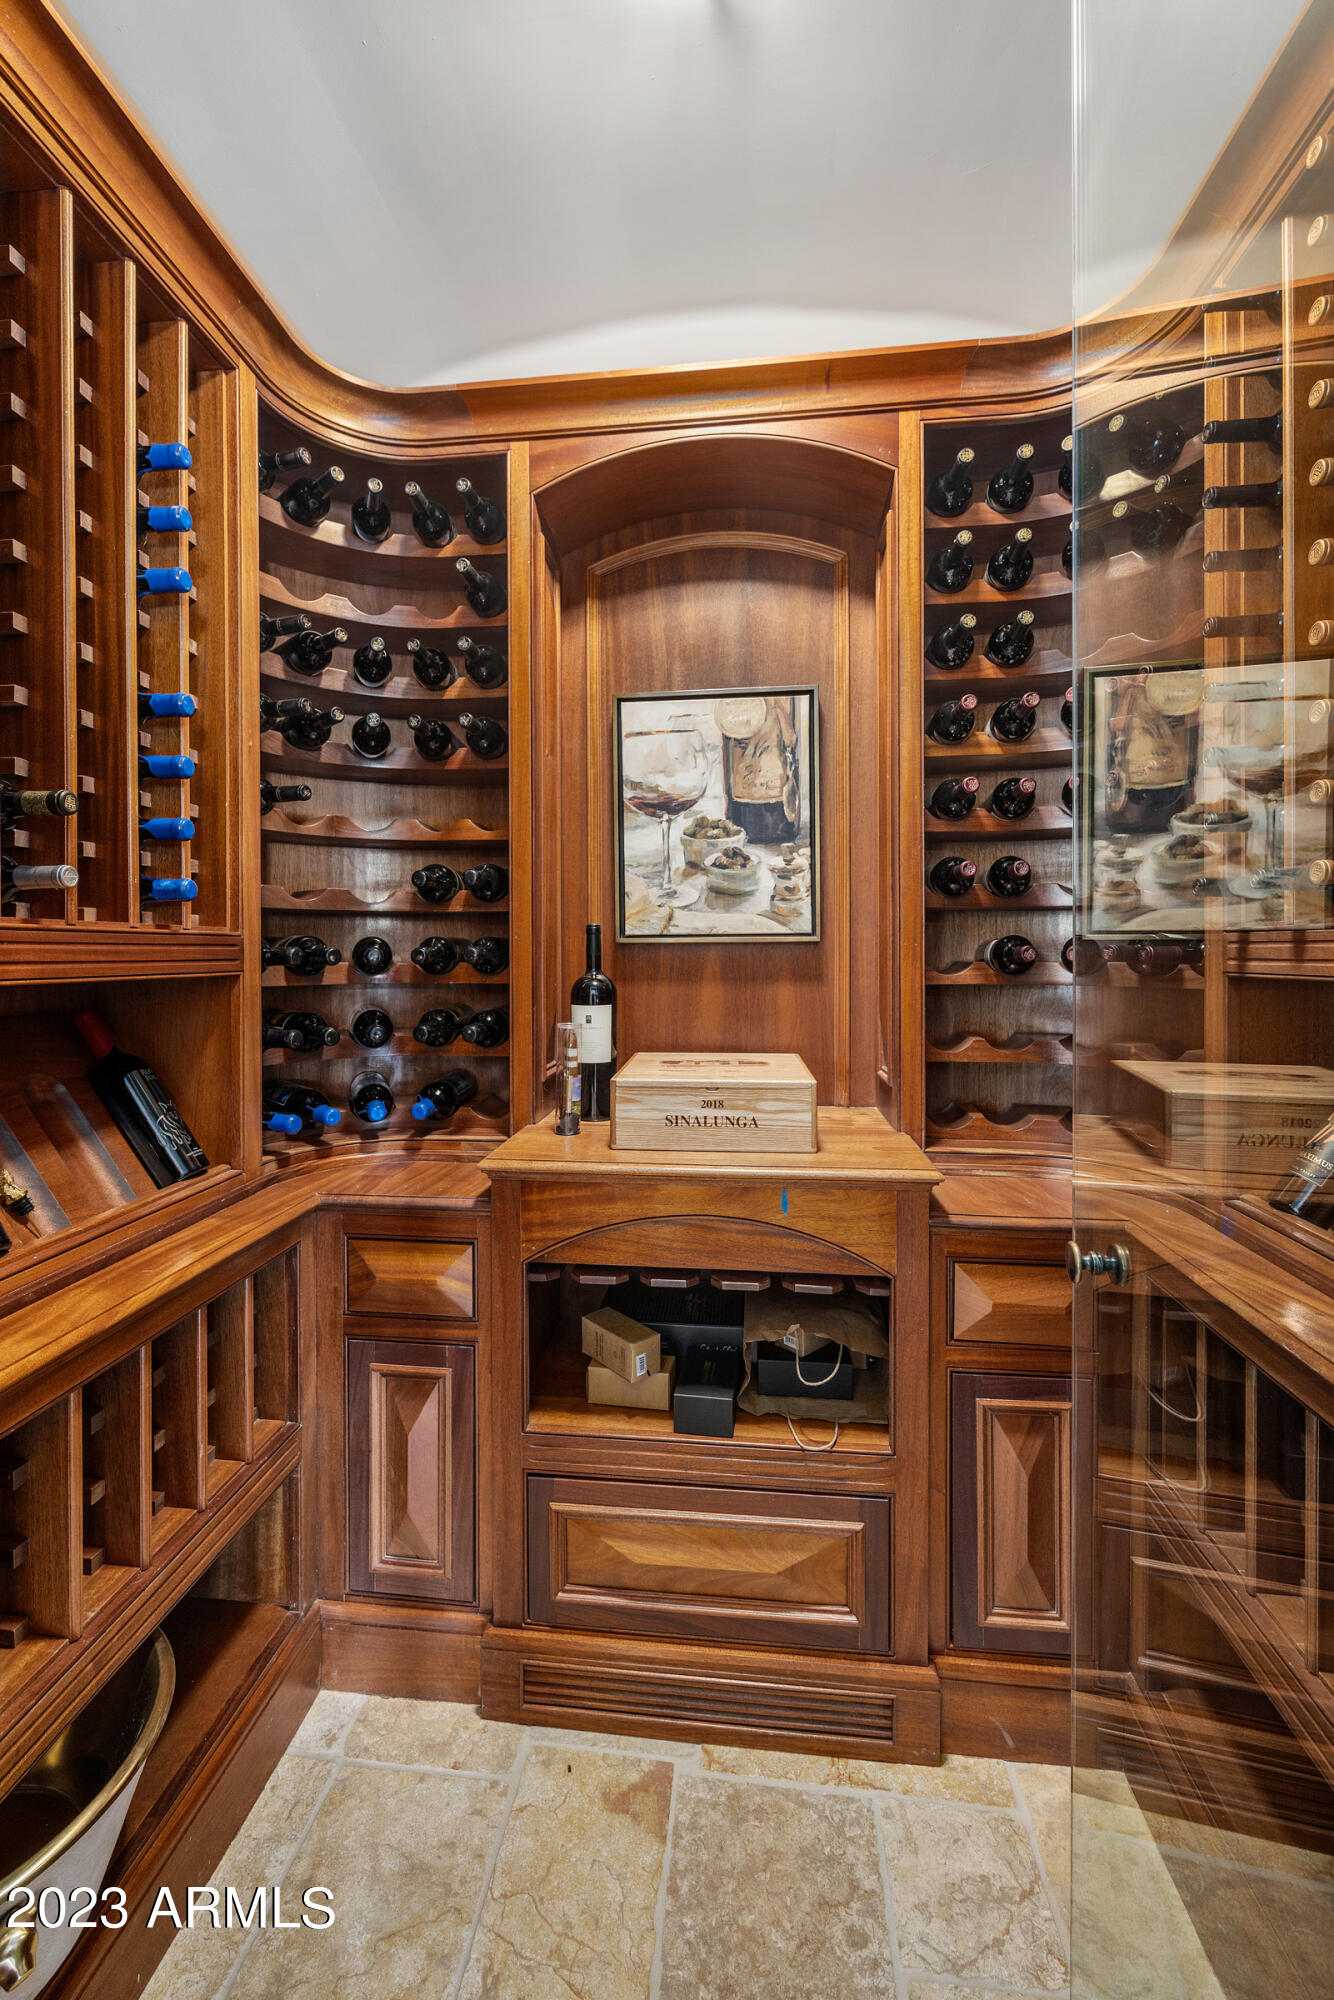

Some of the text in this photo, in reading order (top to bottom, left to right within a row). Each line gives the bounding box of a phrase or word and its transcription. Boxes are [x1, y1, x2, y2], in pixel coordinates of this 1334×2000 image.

[700, 1099, 725, 1109] 2018
[664, 1114, 760, 1129] SINALUNGA
[1302, 1151, 1334, 1171] XIMUS
